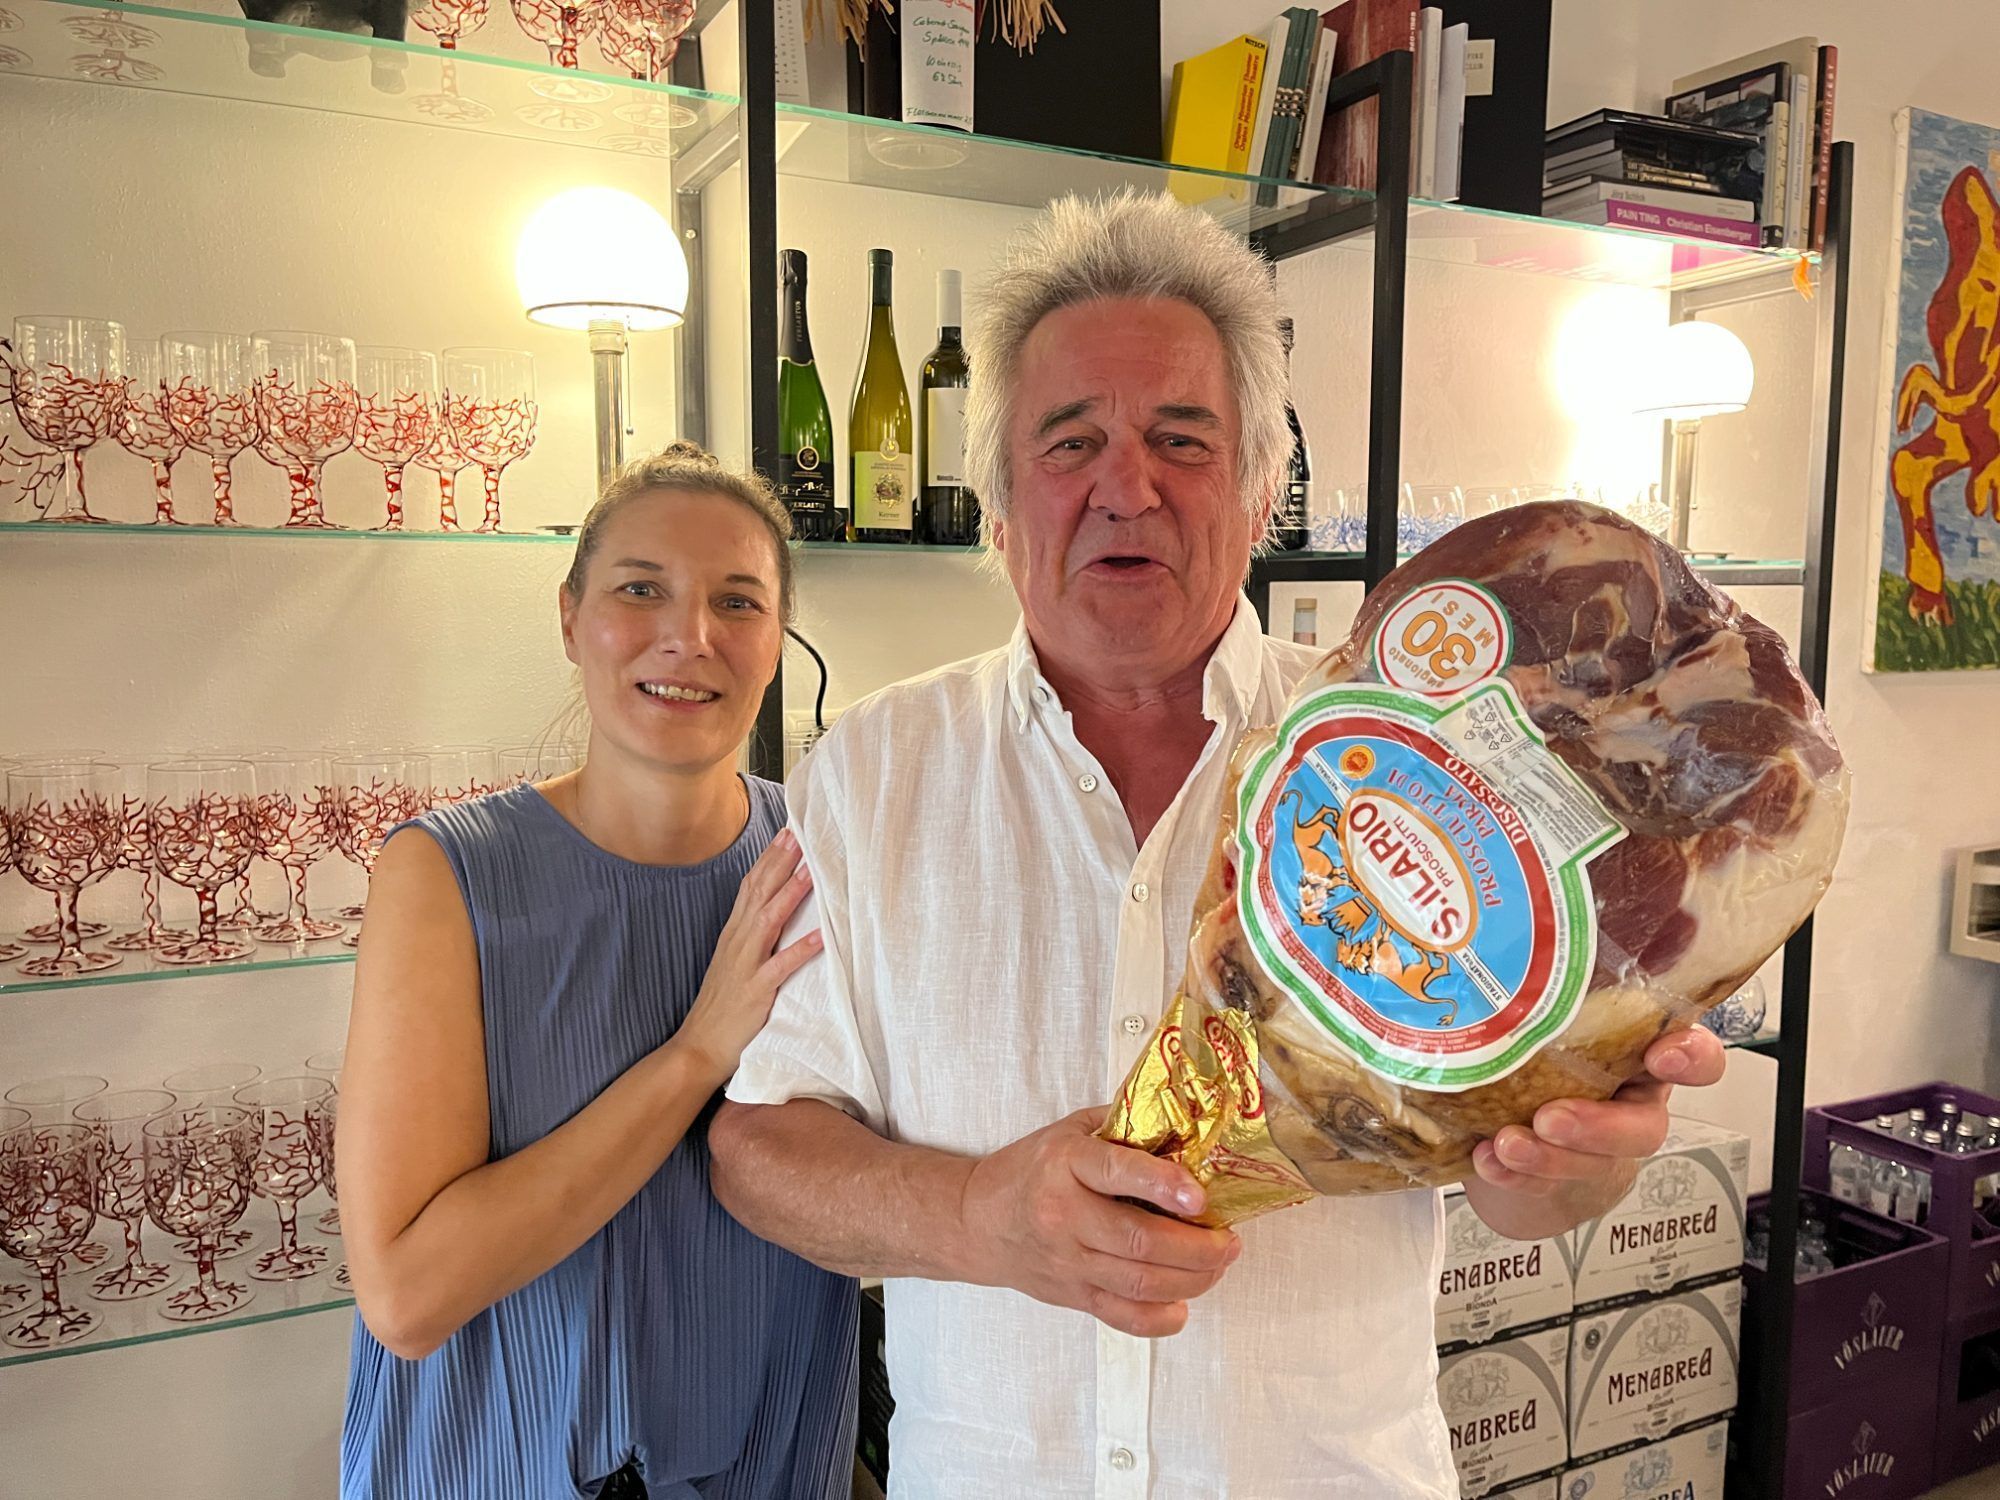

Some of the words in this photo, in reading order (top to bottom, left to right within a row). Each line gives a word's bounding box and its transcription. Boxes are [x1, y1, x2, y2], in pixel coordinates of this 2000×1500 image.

[1819, 178, 1828, 206] DAS
[1666, 217, 1704, 232] Christian
[1704, 224, 1753, 241] Eisenberger
[1401, 610, 1476, 680] 30
[1430, 591, 1496, 649] MESI
[1387, 768, 1409, 790] DI
[1445, 757, 1529, 846] DISOSSATO
[1444, 784, 1496, 841] PARMA
[1349, 802, 1463, 940] S.ILARIO
[1393, 814, 1455, 889] PROSCIUTTI
[1408, 782, 1503, 909] PROSCIUTTO
[1609, 1203, 1718, 1256] MENABREA
[1440, 1244, 1542, 1296] ENABREA
[1834, 1325, 1905, 1371] VÖSLAUER
[1607, 1346, 1713, 1406] MENABREA
[1449, 1398, 1537, 1451] NABREA
[1825, 1452, 1895, 1498] VÖSLAUER
